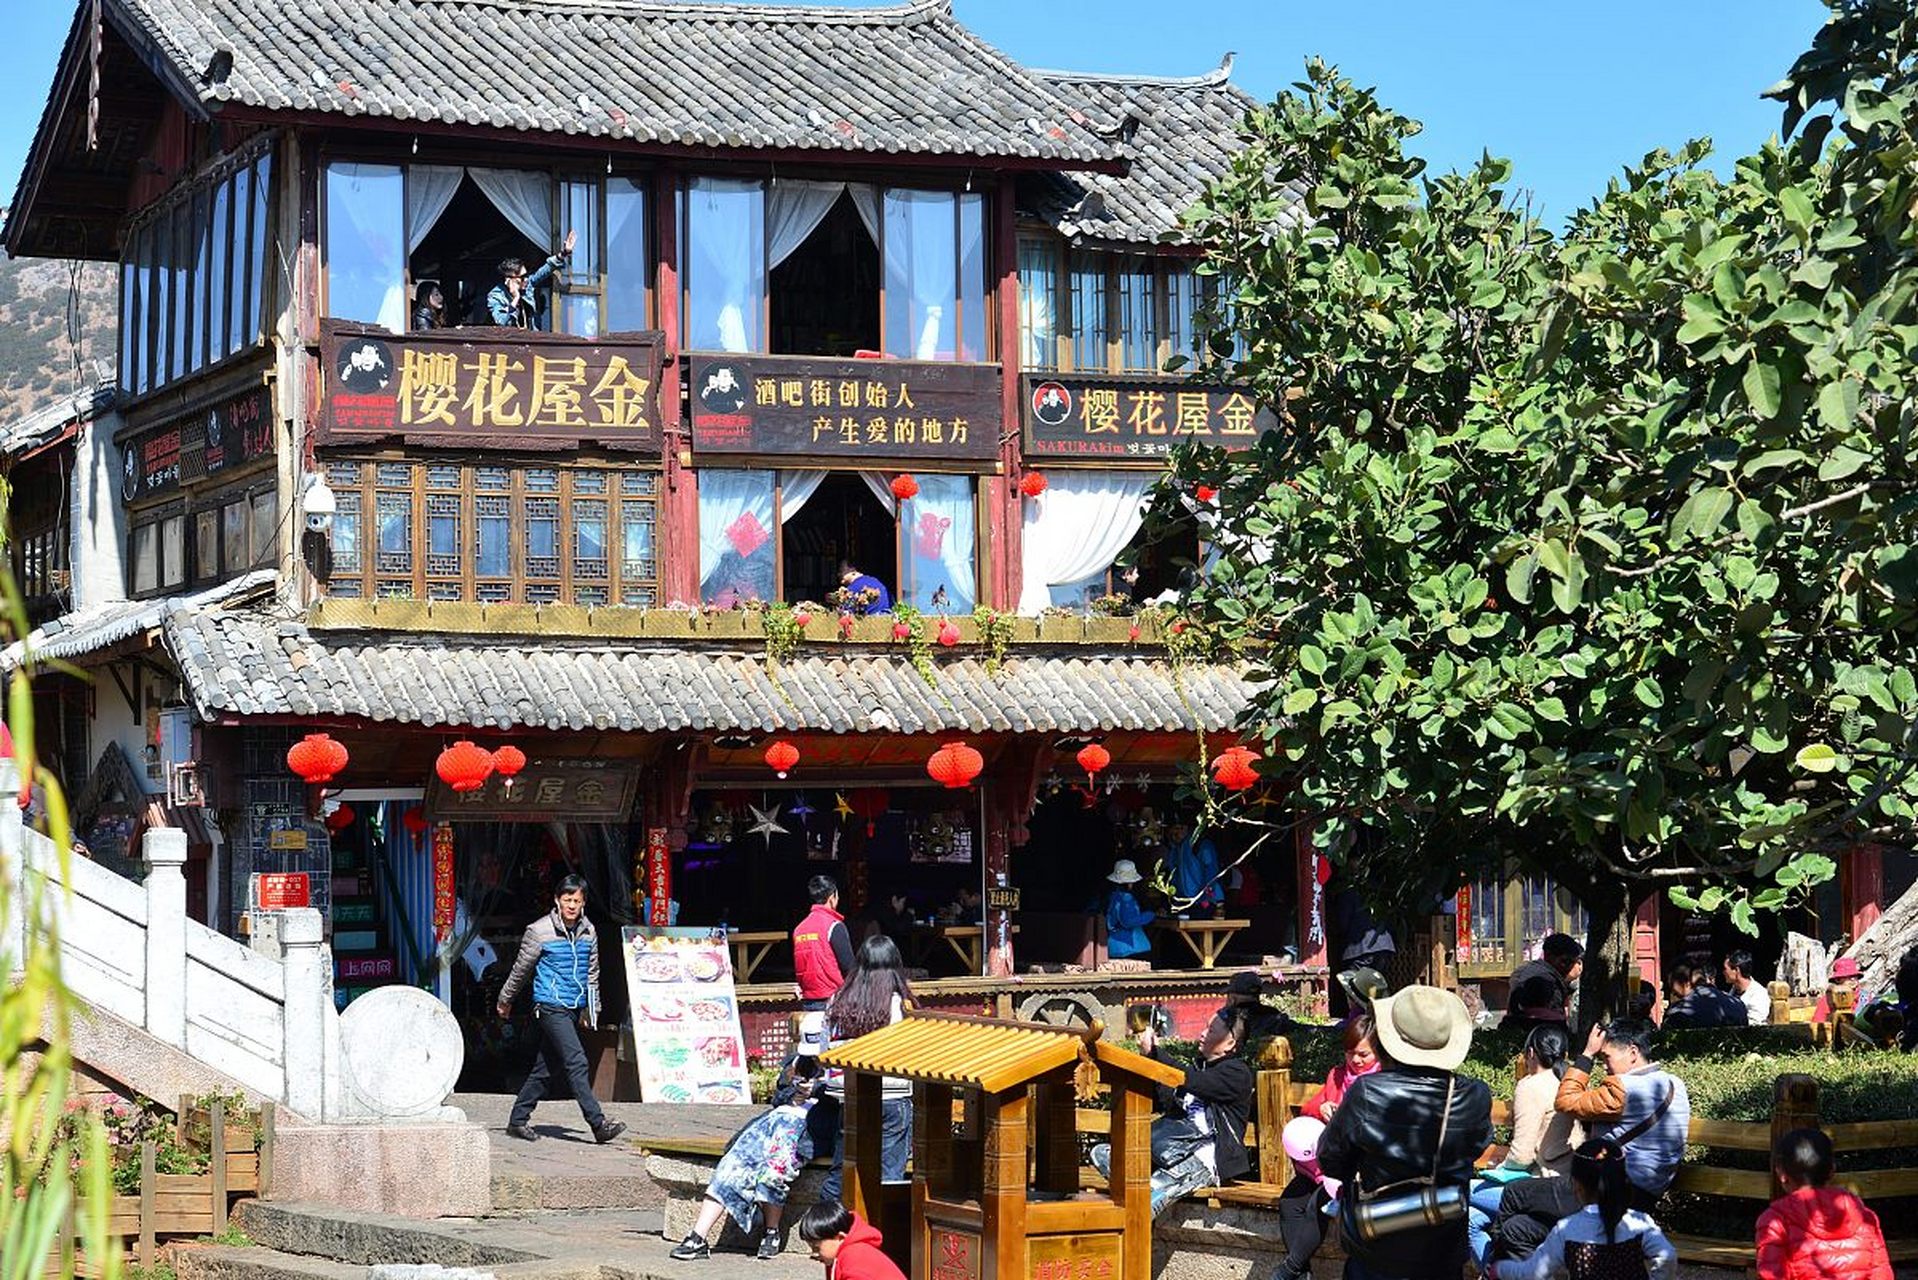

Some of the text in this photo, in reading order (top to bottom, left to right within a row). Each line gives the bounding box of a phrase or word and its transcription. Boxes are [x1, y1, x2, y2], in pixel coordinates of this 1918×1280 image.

[397, 349, 650, 427] 樱花屋金
[754, 378, 915, 410] 酒吧街创始人
[812, 415, 969, 444] 产生爱的地方
[1079, 388, 1257, 435] 樱花屋金
